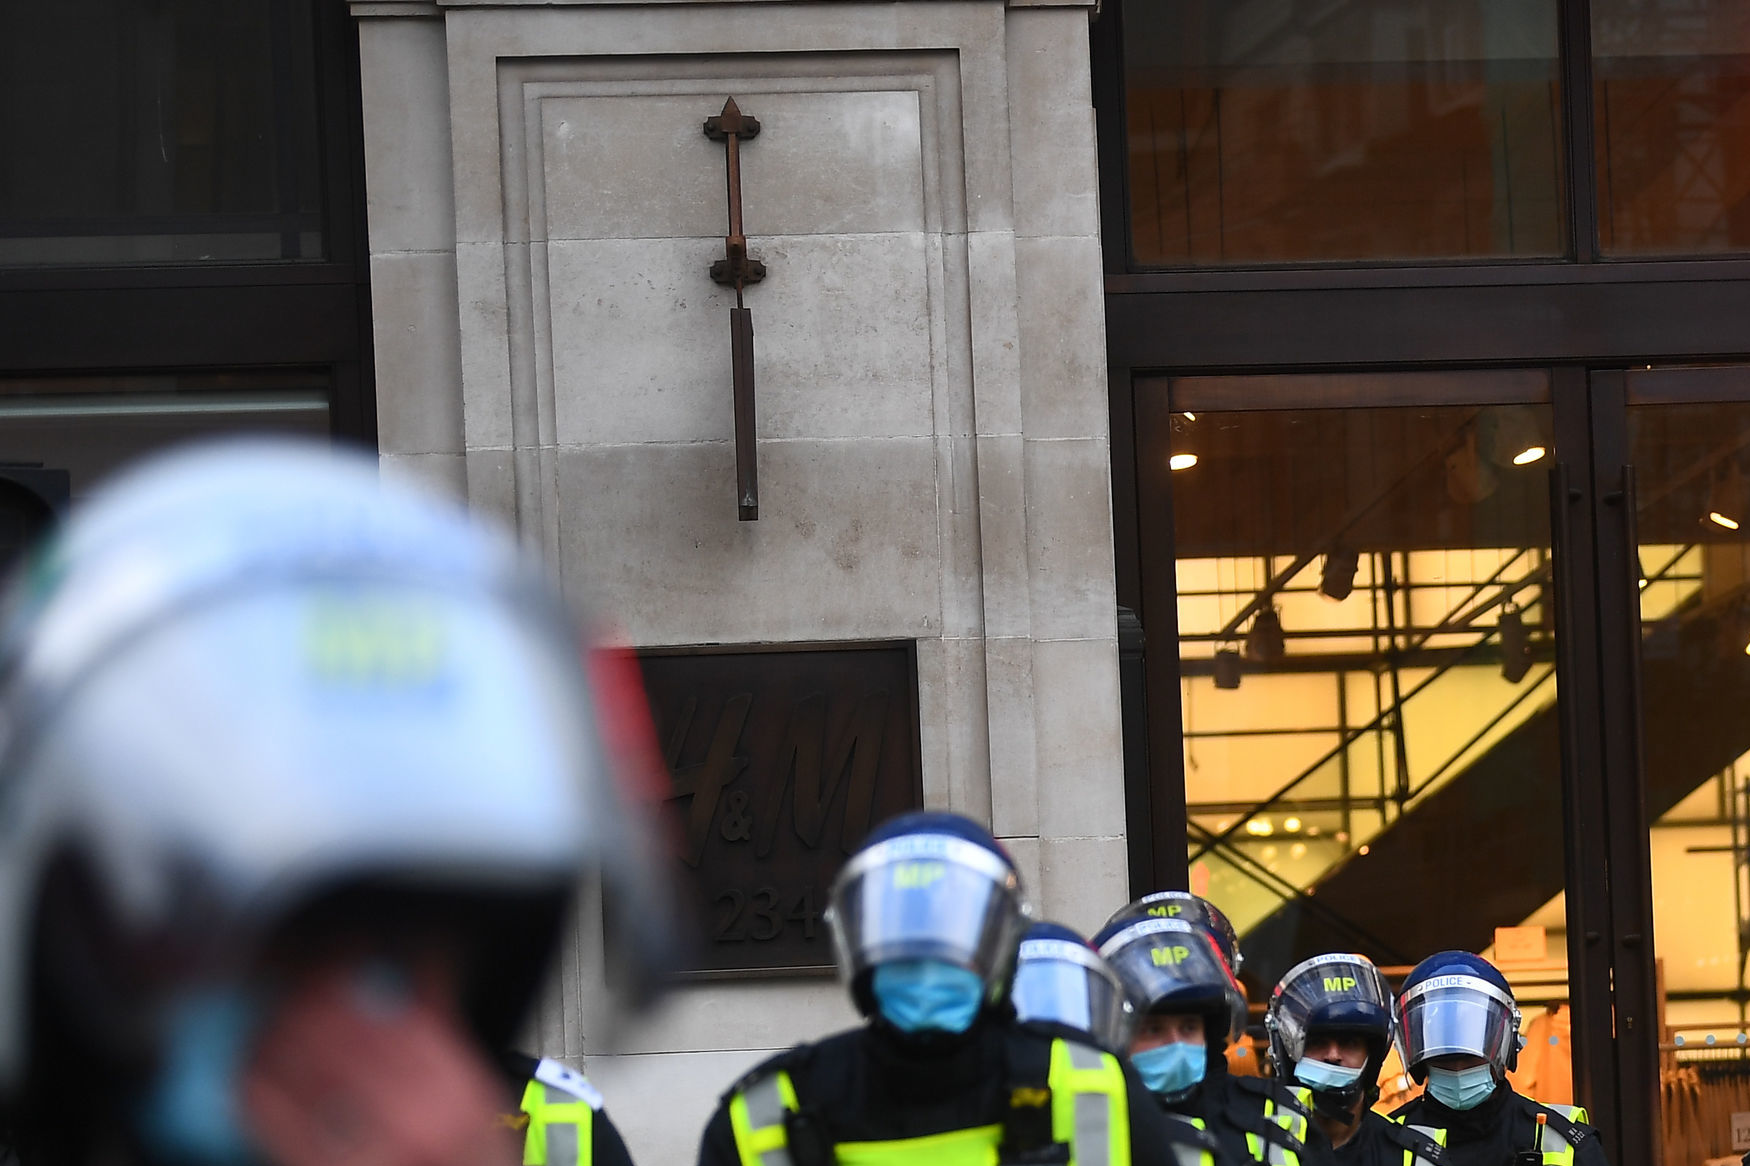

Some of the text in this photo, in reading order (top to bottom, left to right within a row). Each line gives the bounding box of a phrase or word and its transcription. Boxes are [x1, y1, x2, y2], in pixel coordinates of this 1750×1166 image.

[893, 861, 946, 889] MP
[714, 885, 819, 942] 234
[1150, 946, 1190, 967] MP
[1323, 976, 1356, 992] MP
[1424, 976, 1464, 991] POLICE
